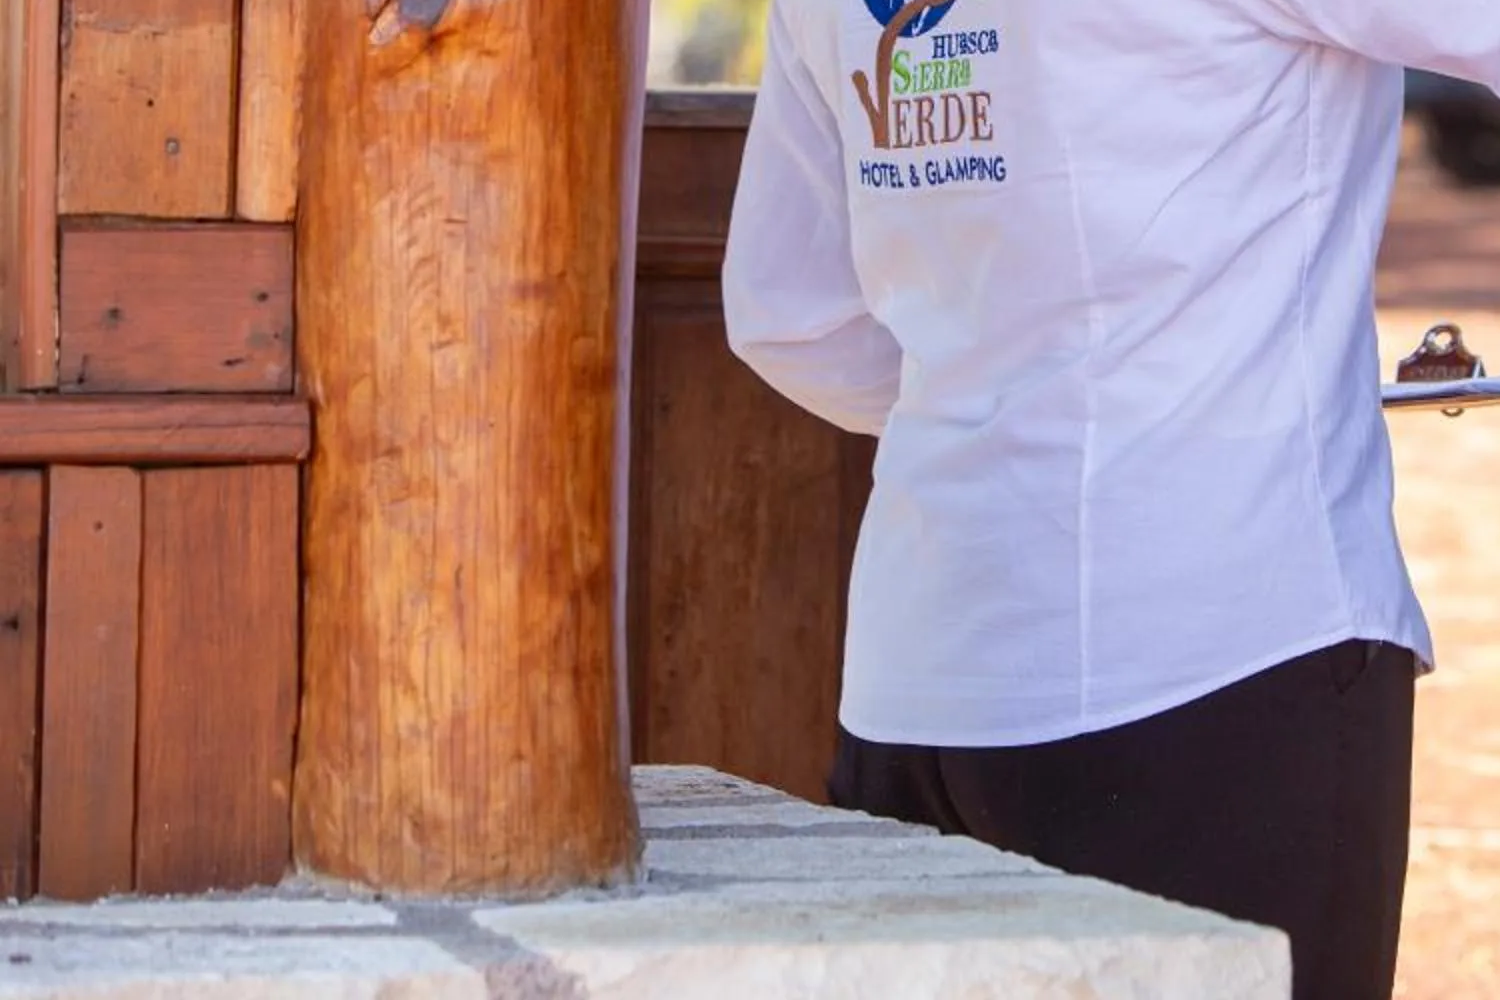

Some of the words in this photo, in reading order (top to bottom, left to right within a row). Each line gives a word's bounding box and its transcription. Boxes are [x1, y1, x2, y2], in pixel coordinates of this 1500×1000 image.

[852, 70, 993, 149] VERDE
[860, 159, 904, 187] HOTEL
[909, 163, 920, 187] &
[925, 155, 1006, 185] GLAMPING
